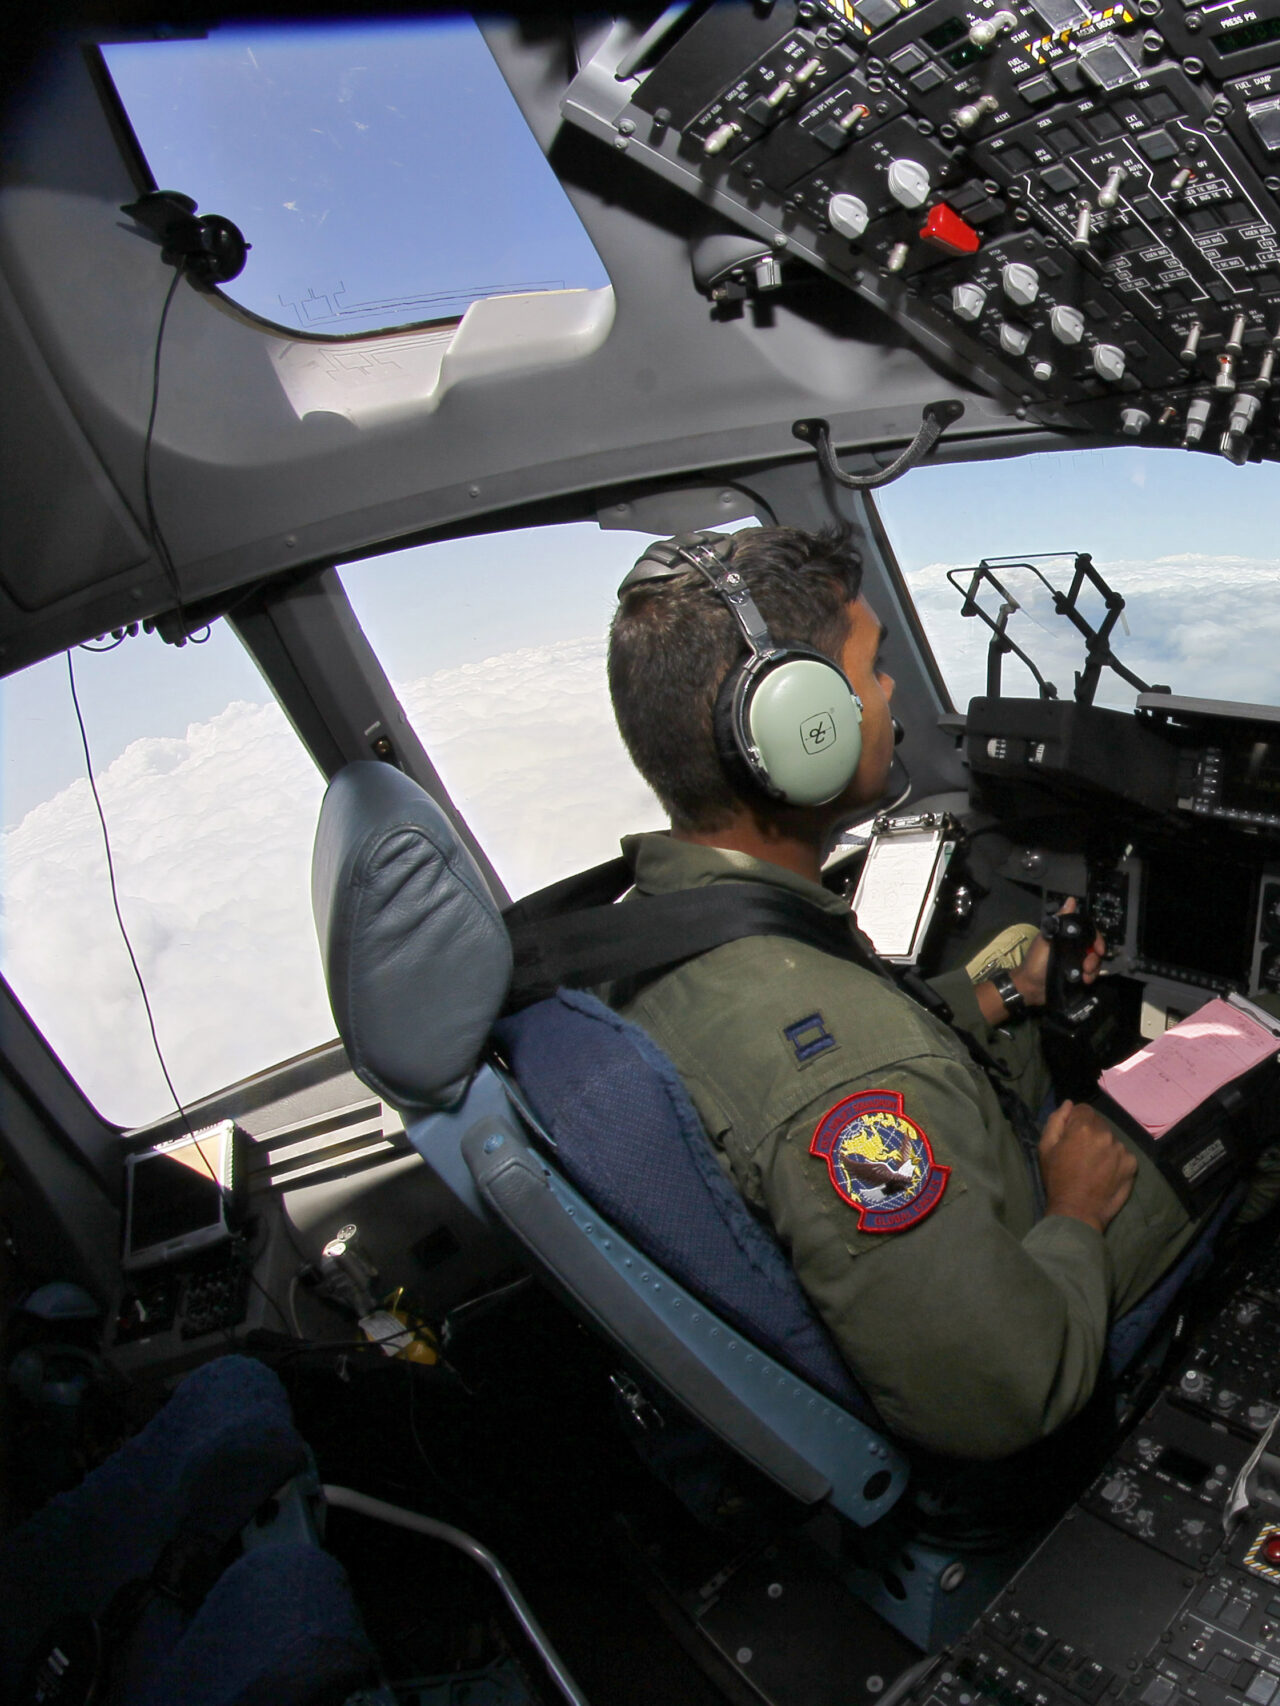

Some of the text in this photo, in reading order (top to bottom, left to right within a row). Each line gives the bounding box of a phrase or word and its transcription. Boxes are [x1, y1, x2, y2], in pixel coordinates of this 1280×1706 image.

[1220, 11, 1257, 28] PRESS PSI
[1076, 18, 1116, 37] AGENT DISCH
[1010, 30, 1031, 43] START
[1049, 48, 1064, 58] ARM
[1008, 56, 1023, 67] FUEL
[1011, 62, 1031, 75] PRESS
[1234, 75, 1272, 91] FUEL DUMP
[994, 112, 1011, 123] ALERT
[1125, 114, 1137, 123] EXT
[1130, 120, 1145, 130] PWR
[1039, 154, 1053, 164] PWR
[1197, 160, 1208, 168] OFF
[874, 1179, 940, 1226] GLOBAL EAGLES
